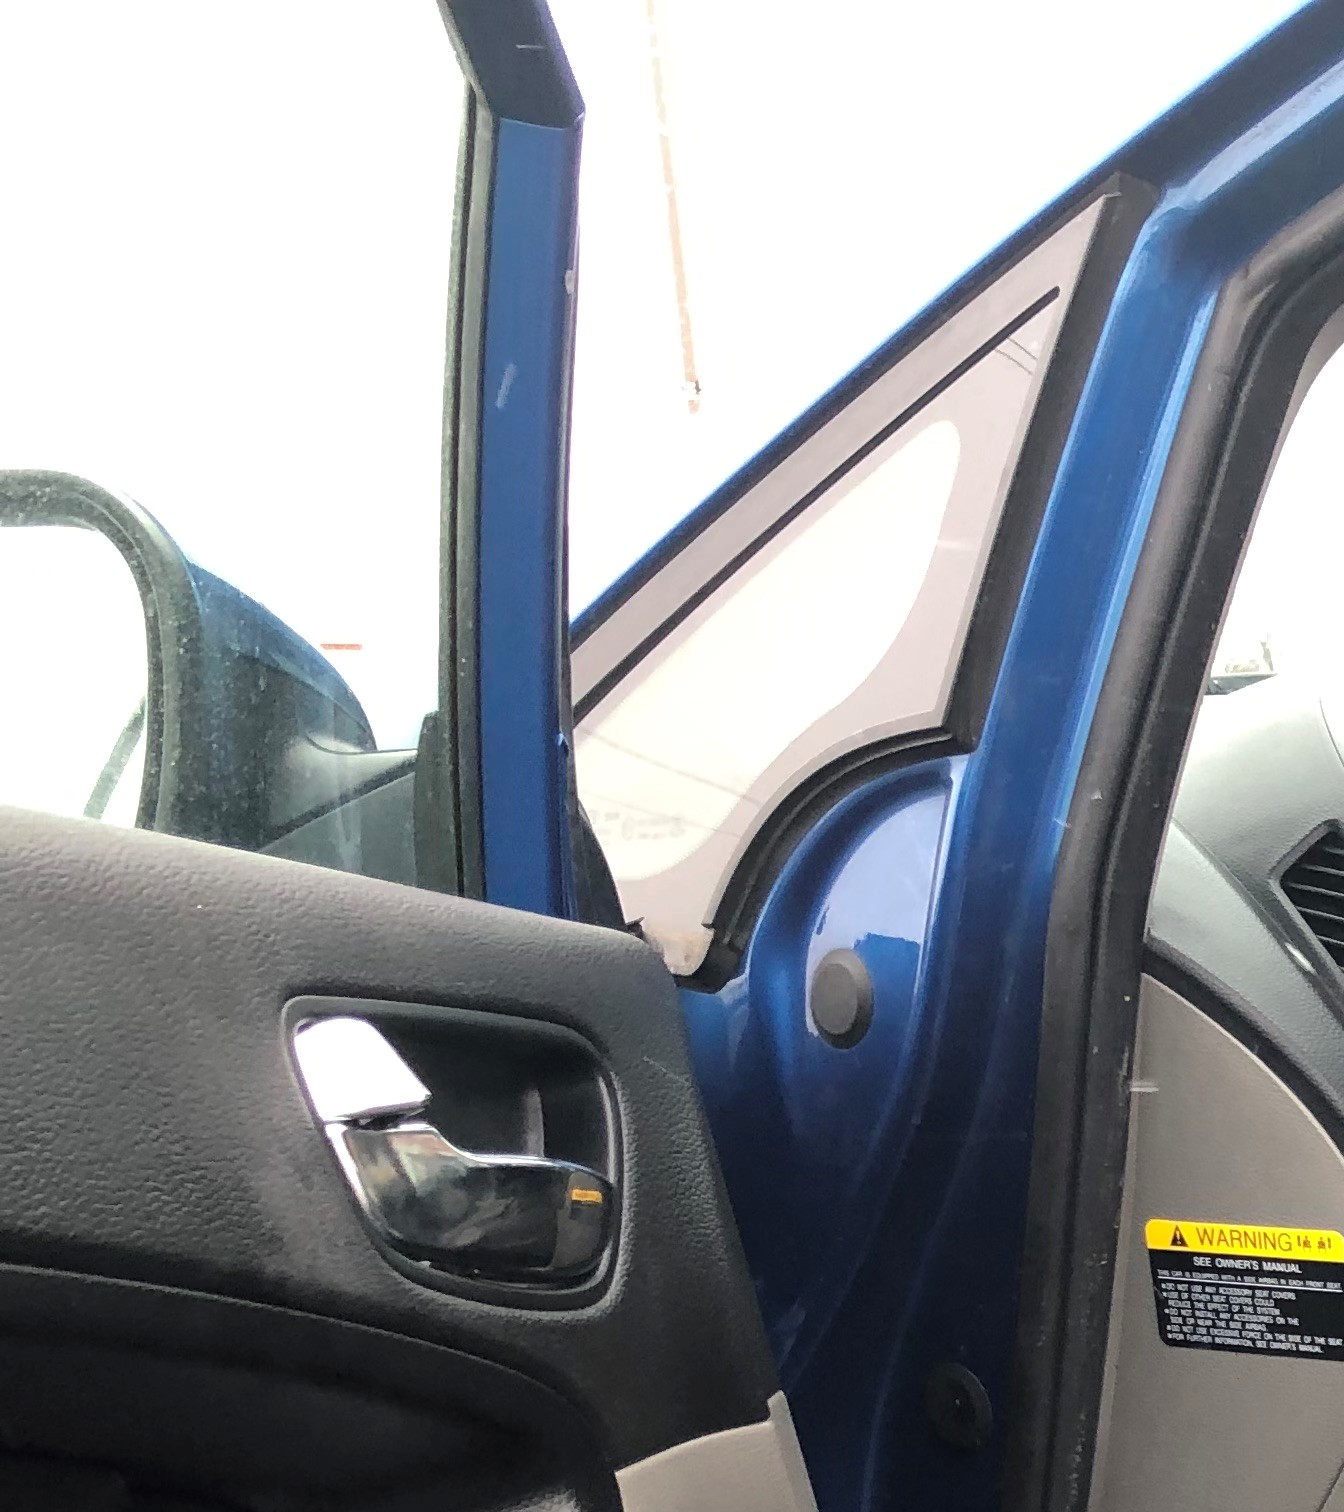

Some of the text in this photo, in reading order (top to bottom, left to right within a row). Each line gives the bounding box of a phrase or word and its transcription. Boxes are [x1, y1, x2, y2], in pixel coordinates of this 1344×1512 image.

[1195, 1226, 1293, 1251] WARNING
[1192, 1256, 1302, 1273] SEE OWNER'S MANUAL
